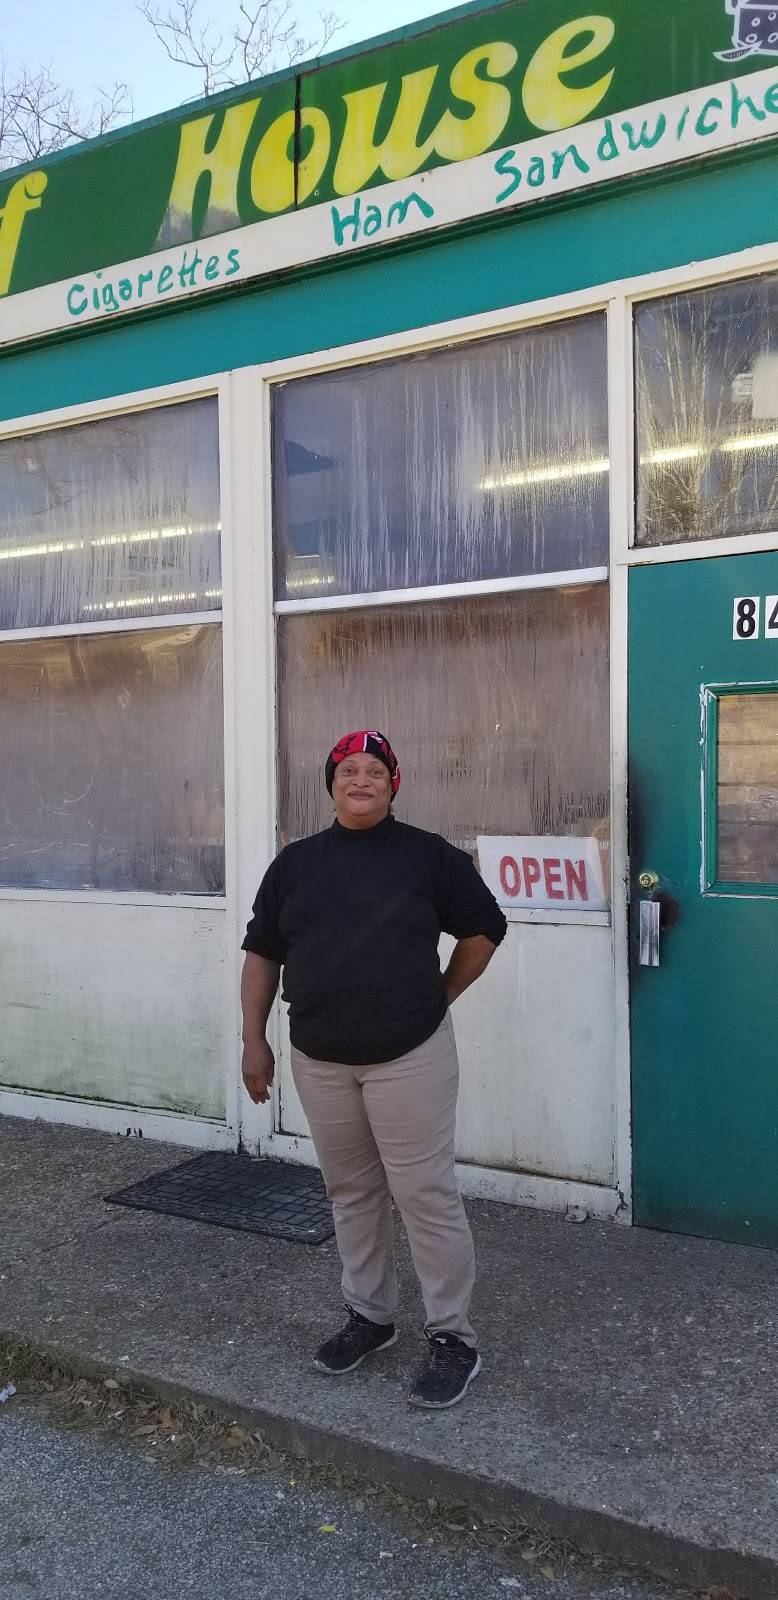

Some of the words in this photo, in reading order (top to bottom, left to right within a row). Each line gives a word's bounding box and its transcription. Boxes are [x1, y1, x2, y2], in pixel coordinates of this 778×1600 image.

[152, 15, 615, 248] House
[331, 197, 435, 246] Ham
[66, 248, 241, 315] Cigarettes
[500, 855, 589, 901] OPEN
